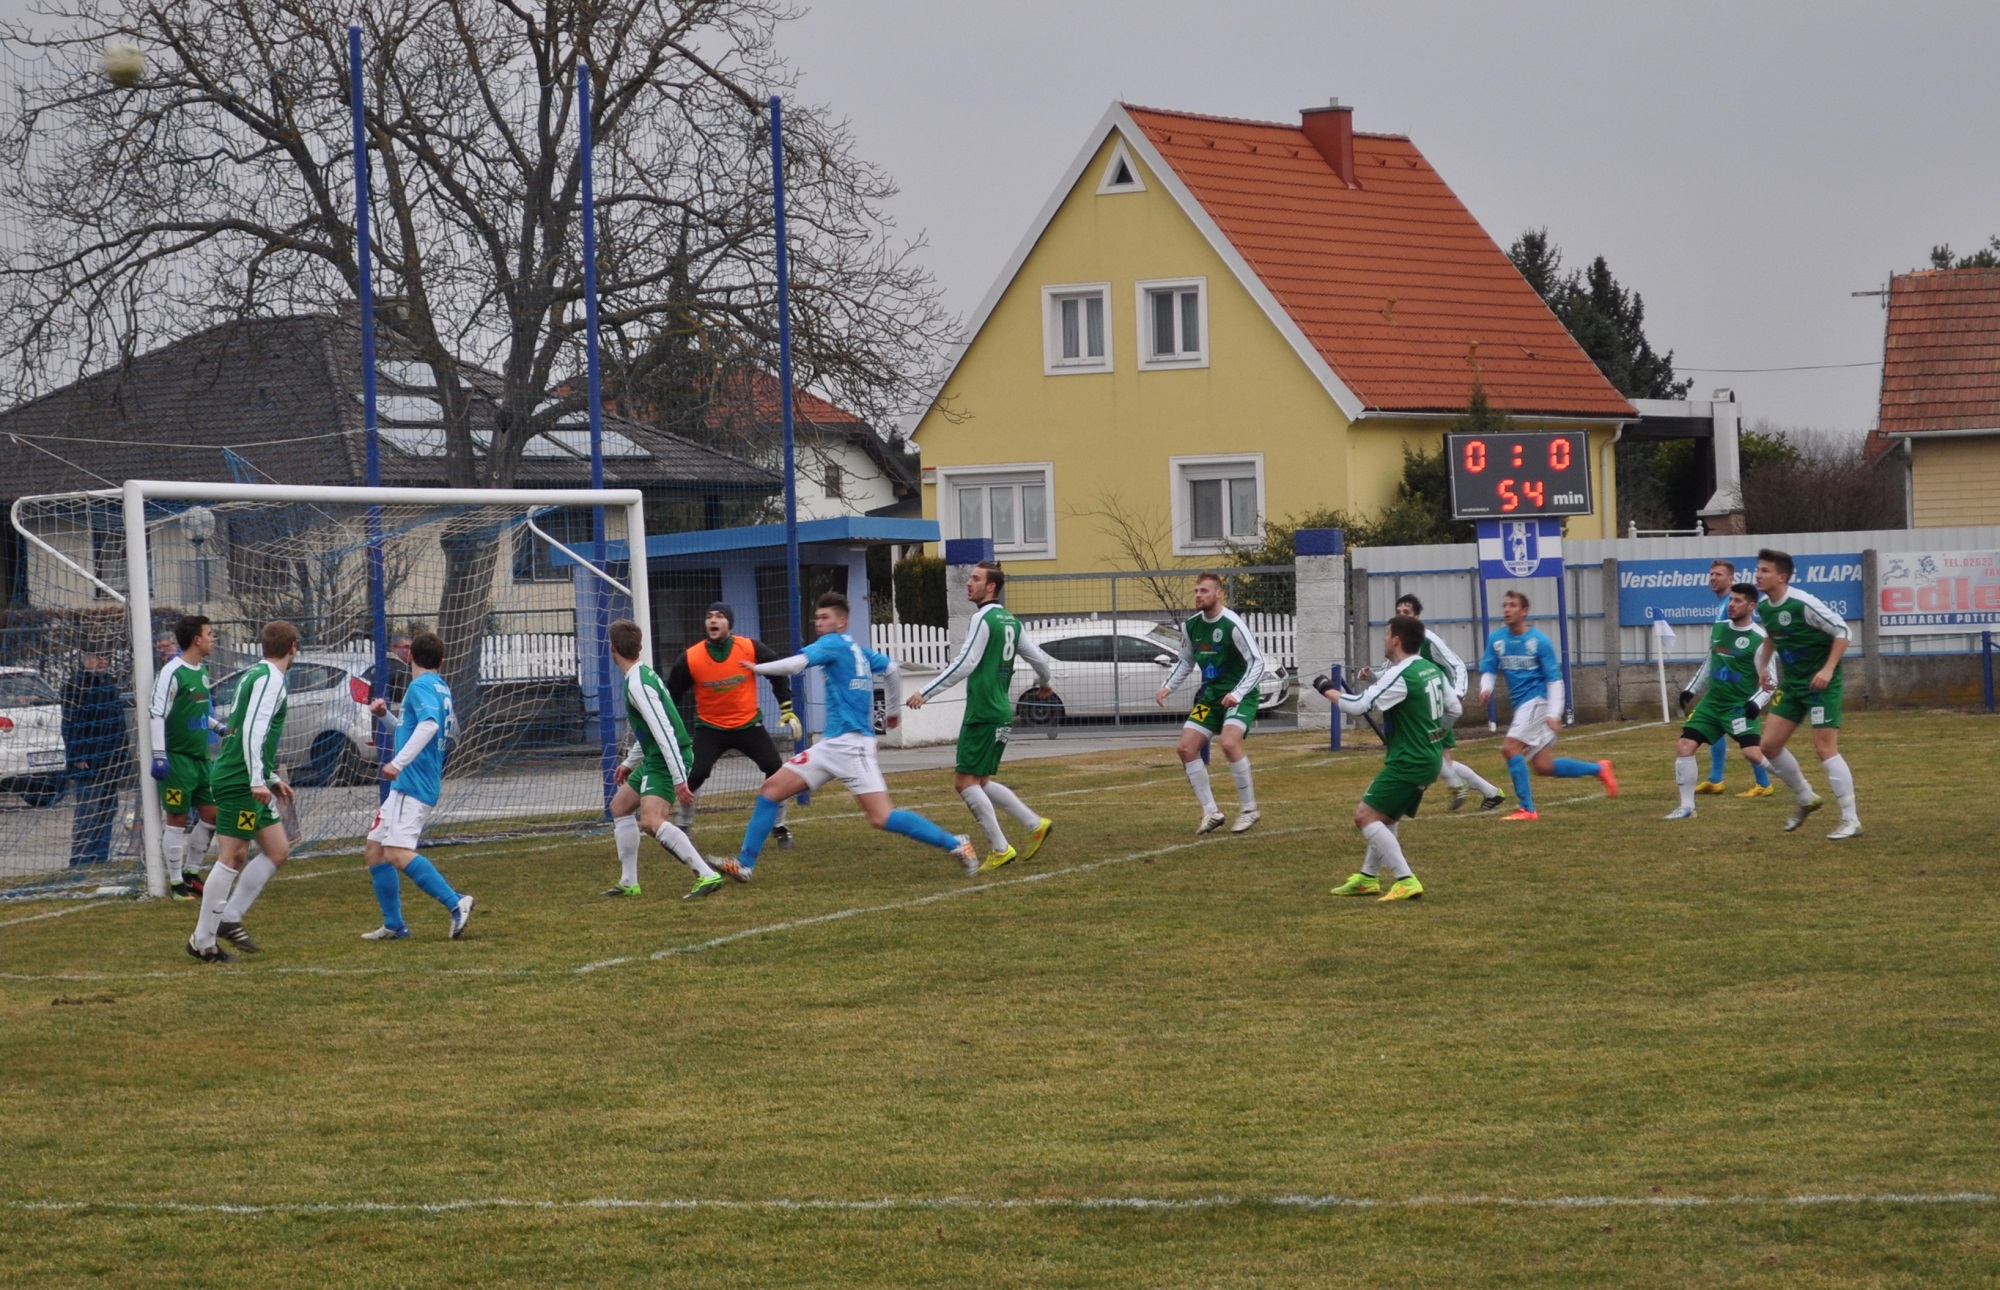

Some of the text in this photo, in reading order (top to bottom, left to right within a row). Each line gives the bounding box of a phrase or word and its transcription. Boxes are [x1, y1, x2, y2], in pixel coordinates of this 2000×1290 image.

[1465, 440, 1486, 473] 0
[1549, 438, 1571, 470] 0
[1498, 478, 1584, 511] 54 min
[1881, 614, 1950, 626] BAUMARKT
[1002, 624, 1016, 662] 8
[1424, 676, 1445, 721] 15
